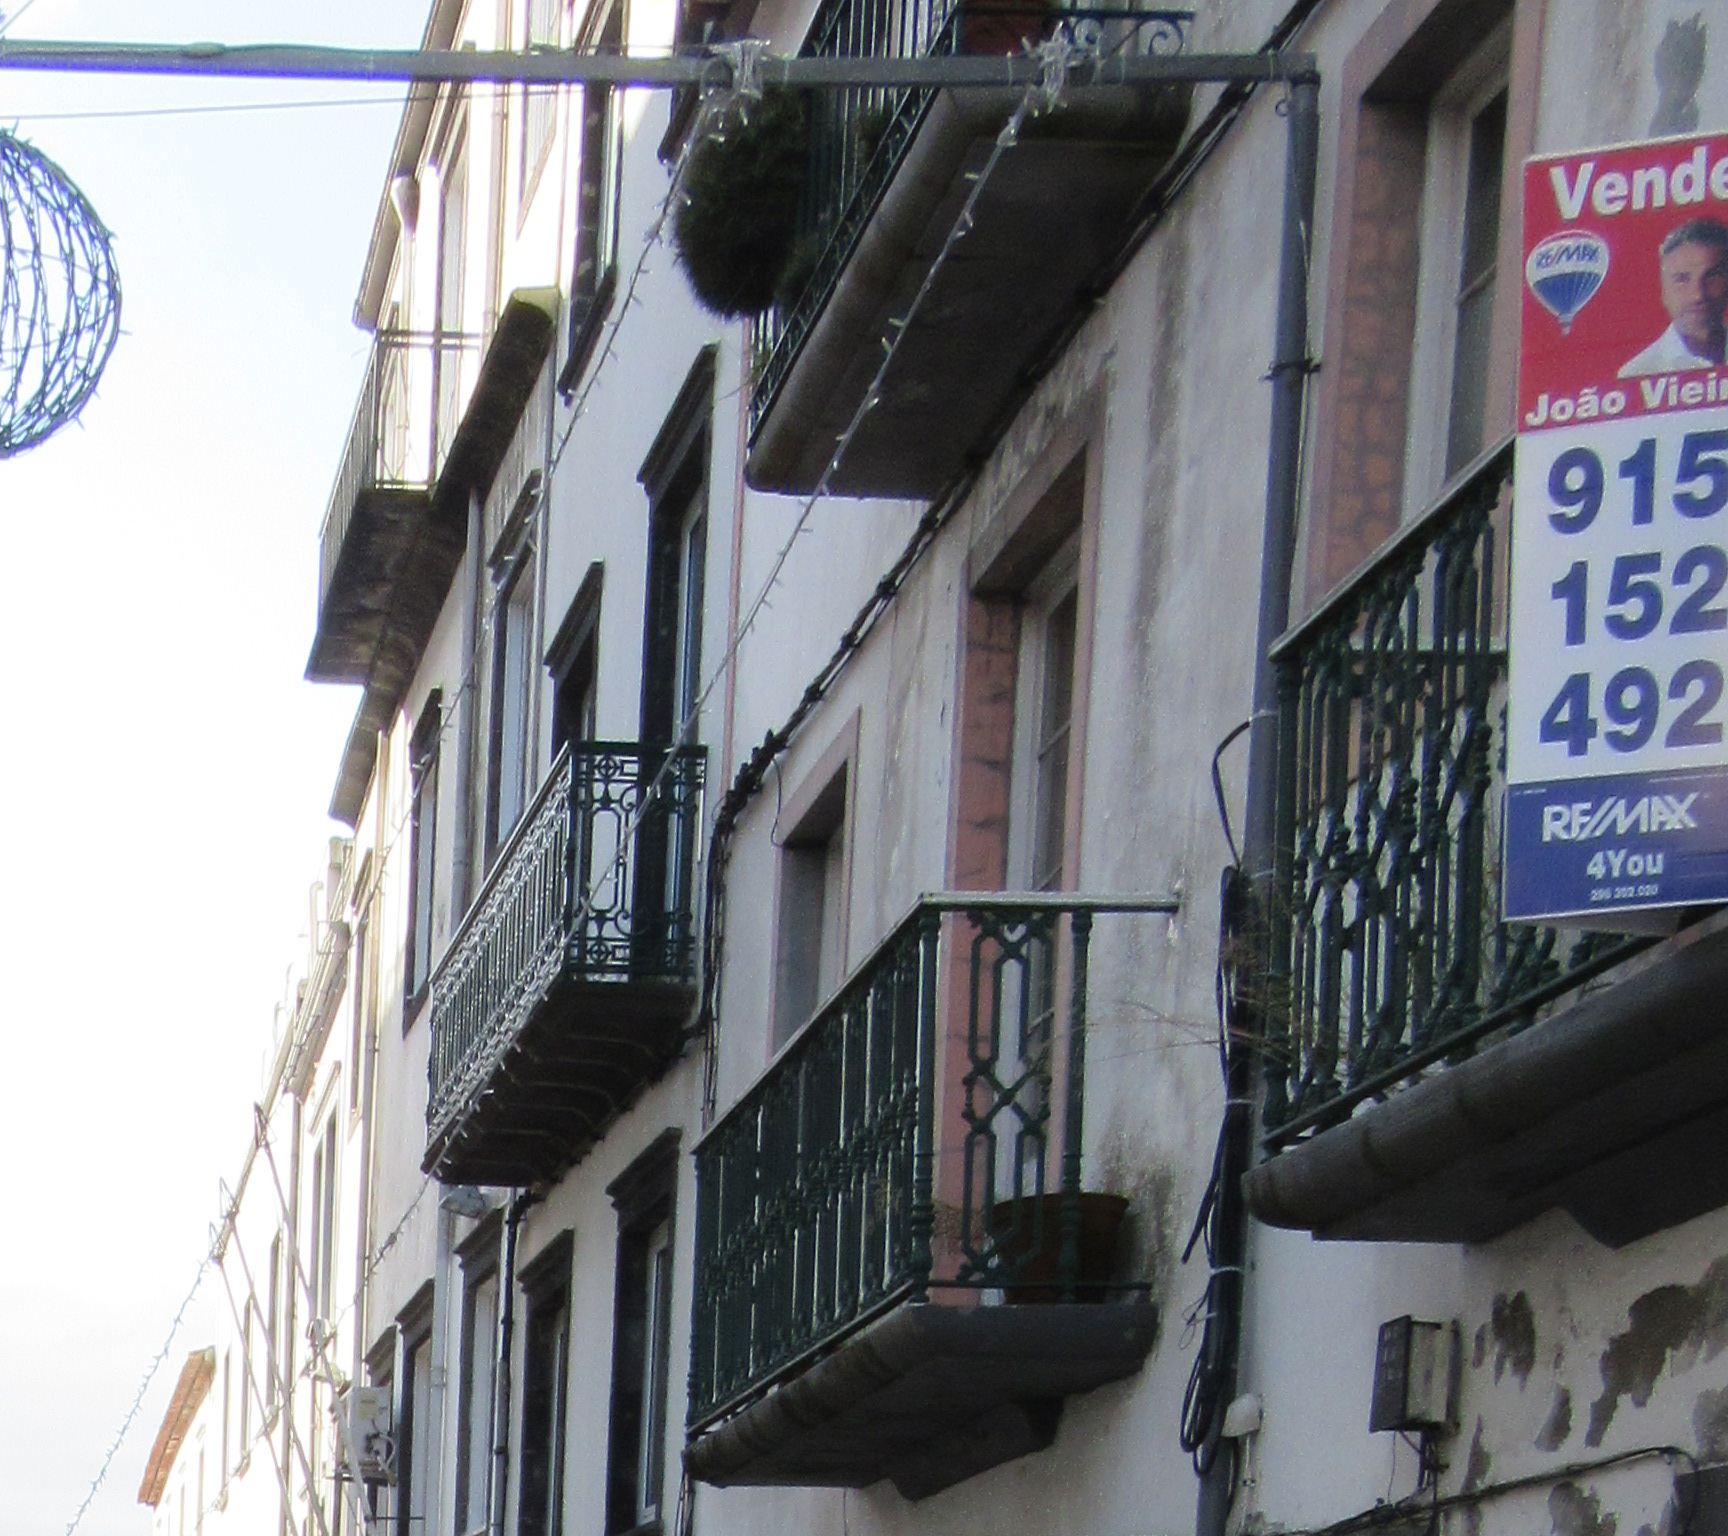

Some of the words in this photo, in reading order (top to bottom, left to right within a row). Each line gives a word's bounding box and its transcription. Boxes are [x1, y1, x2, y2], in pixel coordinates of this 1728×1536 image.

[1525, 386, 1626, 427] João
[1548, 430, 1728, 535] 915
[1551, 544, 1728, 647] 152
[1539, 659, 1725, 758] 492
[1542, 792, 1699, 843] RE/MAX
[1586, 849, 1665, 880] 4You
